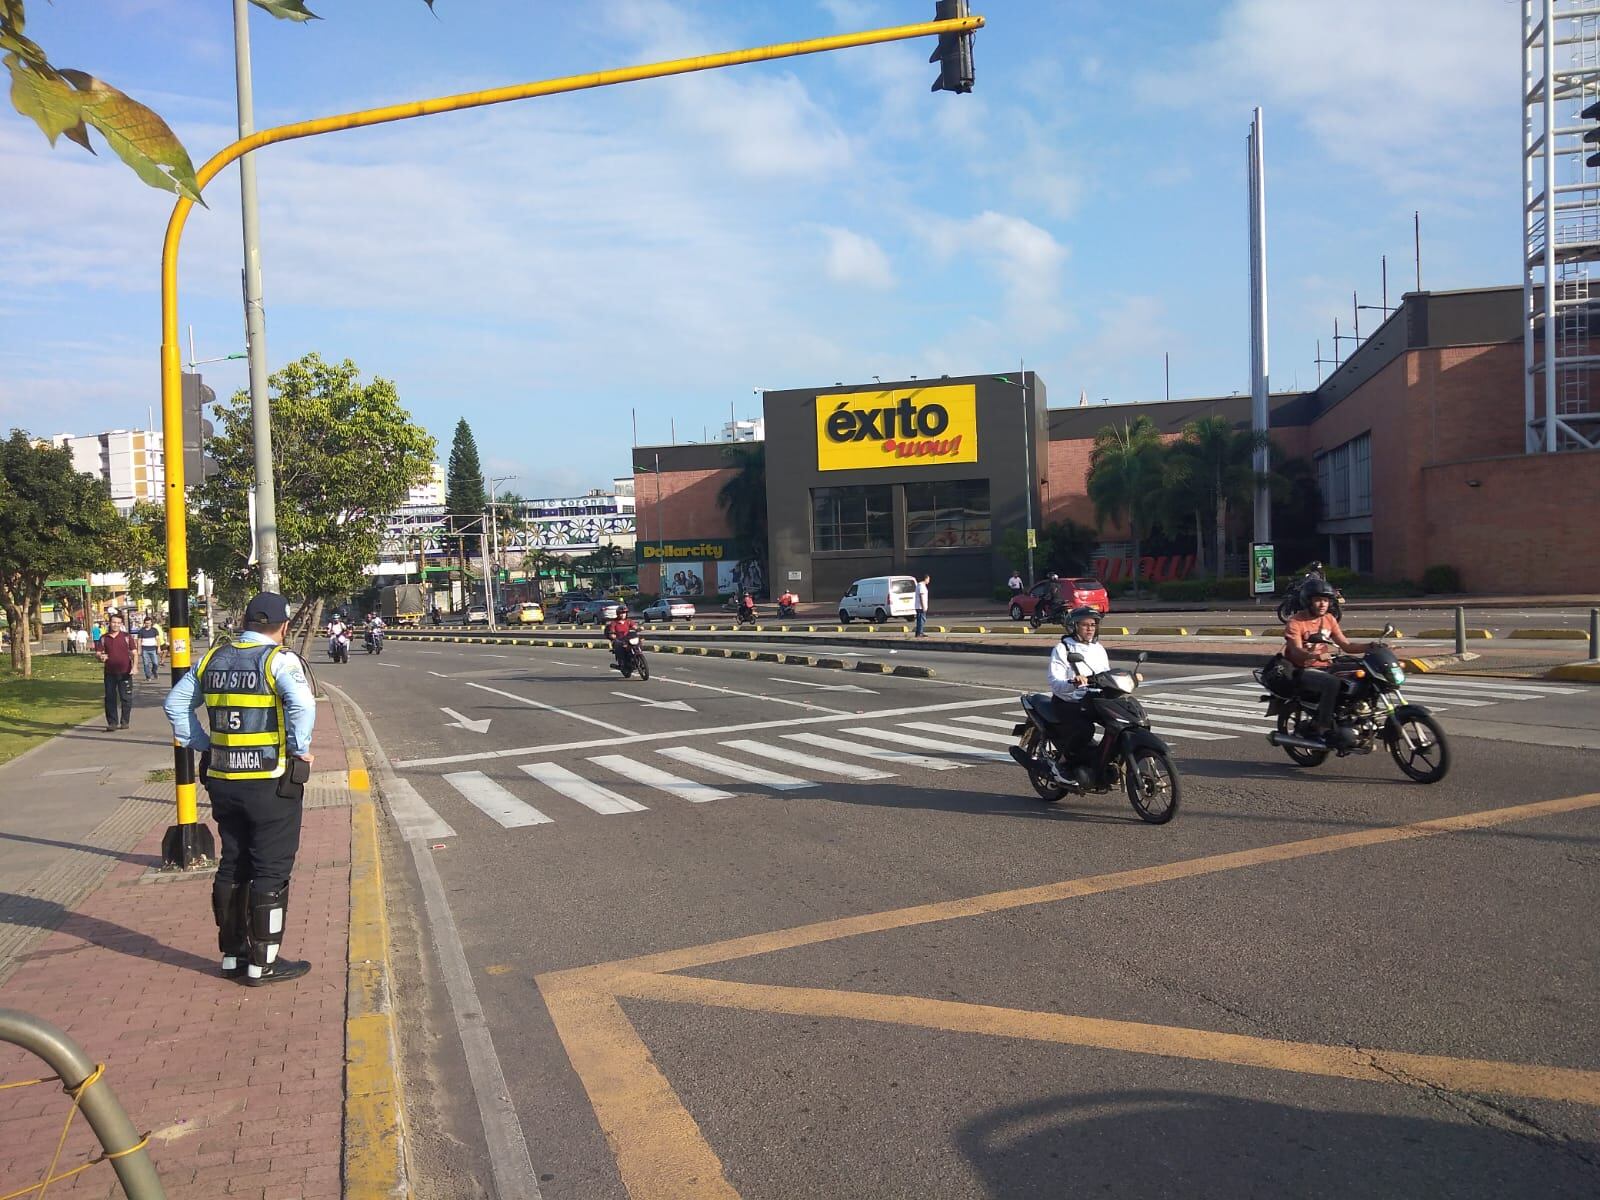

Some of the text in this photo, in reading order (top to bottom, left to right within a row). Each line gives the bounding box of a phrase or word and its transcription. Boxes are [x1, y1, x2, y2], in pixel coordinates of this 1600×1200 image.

[826, 397, 949, 442] éxito
[643, 543, 723, 559] Dollarcity
[226, 751, 261, 770] MANGA
